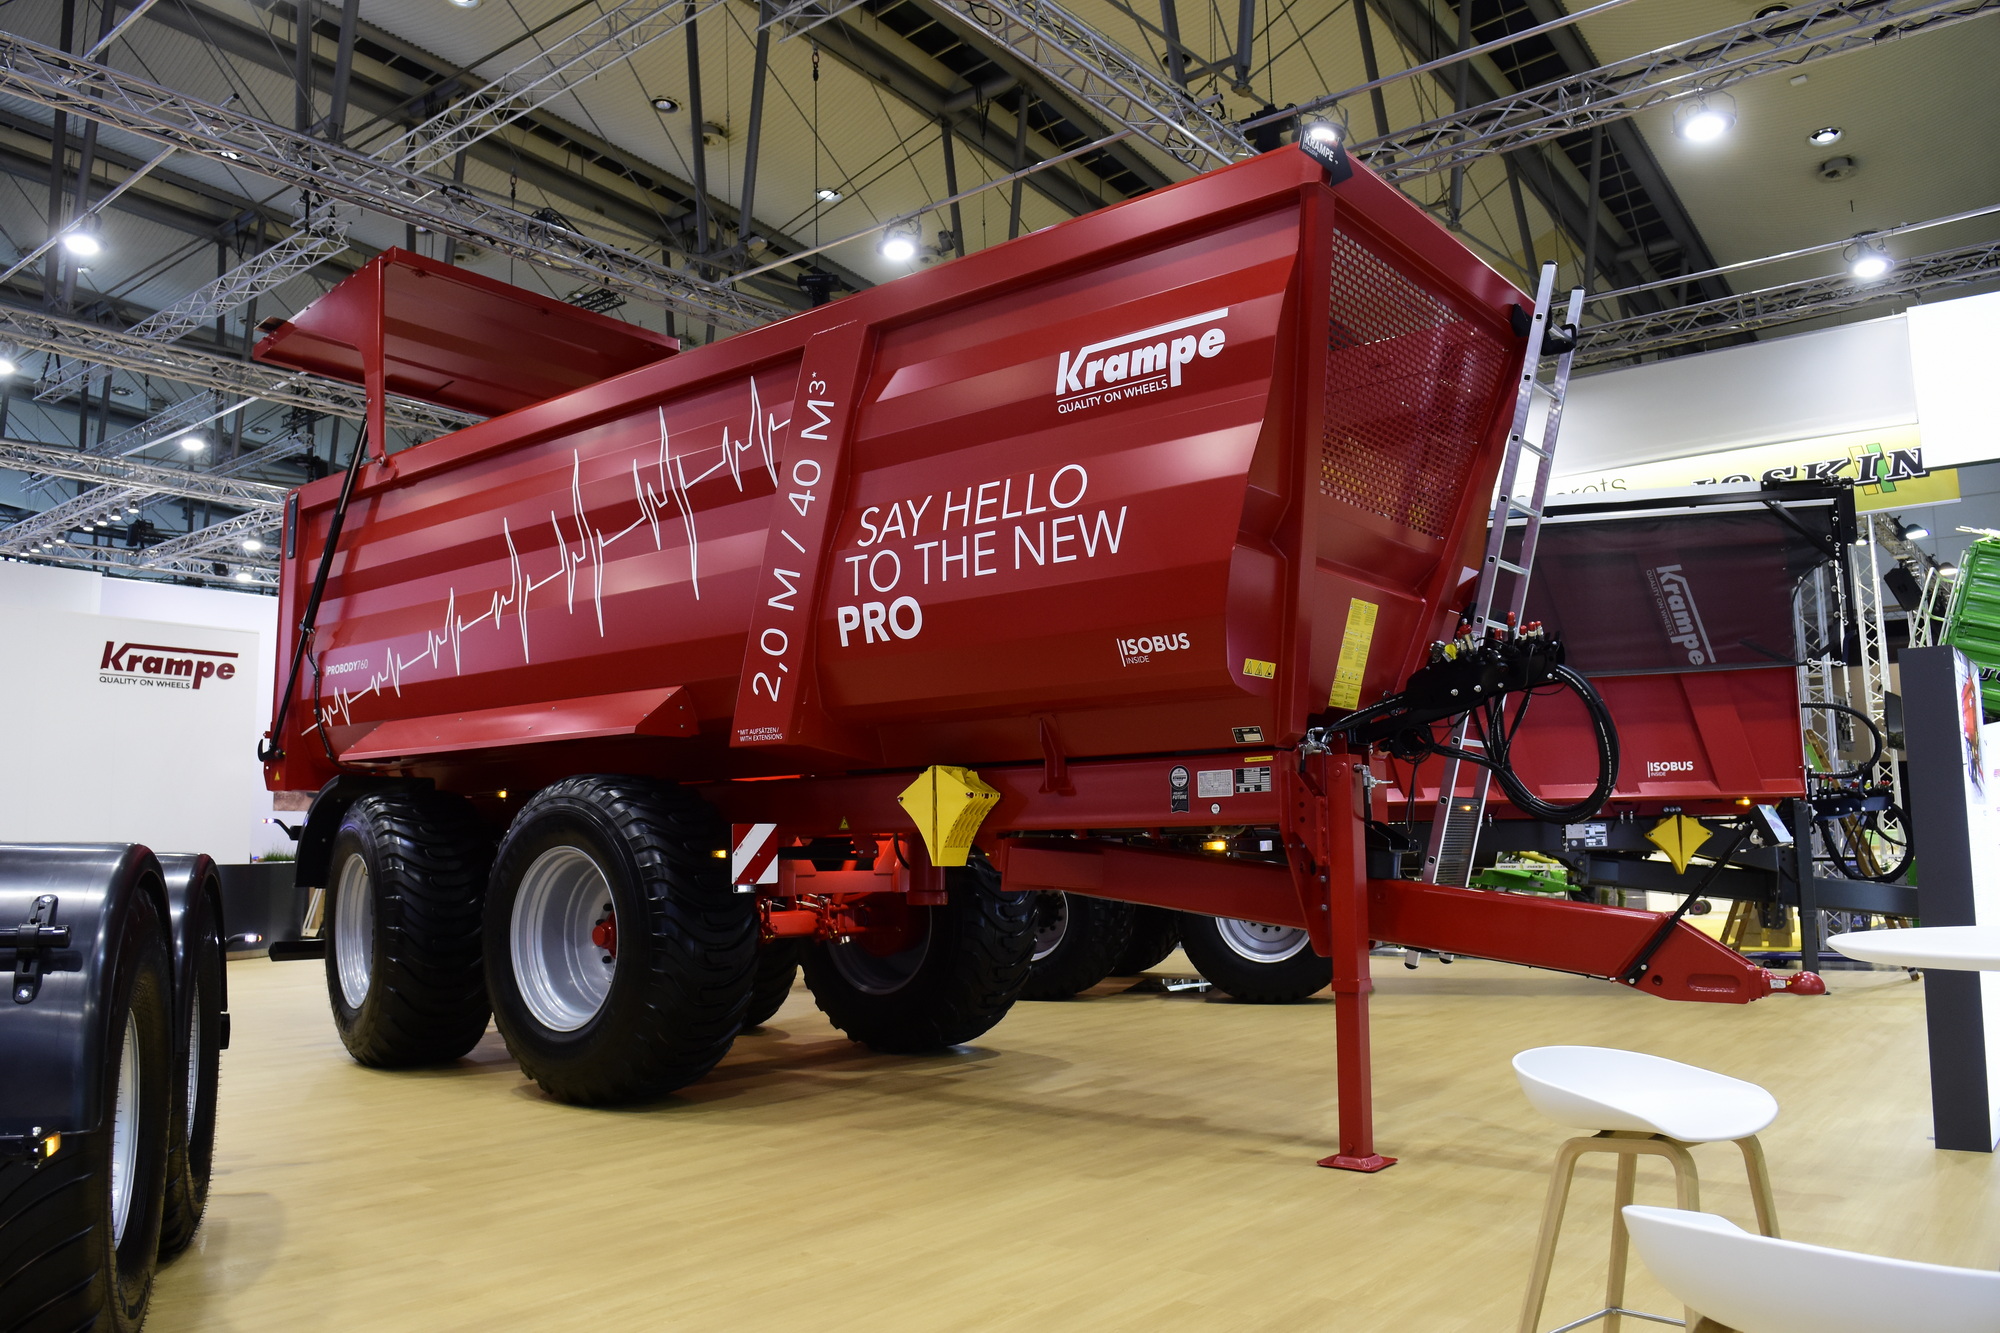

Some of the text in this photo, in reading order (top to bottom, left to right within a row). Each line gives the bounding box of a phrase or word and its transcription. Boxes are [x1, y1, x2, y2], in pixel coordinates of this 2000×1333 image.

[1056, 307, 1229, 395] Krampe
[1057, 379, 1168, 414] QUALITY ON WHEELS
[788, 459, 821, 516] 40
[857, 464, 1088, 547] SAY HELLO
[781, 529, 806, 553] /
[845, 505, 1127, 596] TO THE NEW
[768, 568, 800, 611] M
[1646, 569, 1675, 636] QUALITY ON WHEELS
[837, 595, 923, 647] PRO
[1656, 564, 1717, 666] Krampe
[100, 641, 239, 690] Krampe
[752, 628, 788, 701] 2,0
[1121, 632, 1191, 656] ISOBUS
[1125, 655, 1150, 665] INSIDE
[99, 676, 138, 686] QUALITY
[155, 681, 190, 689] WHEELS
[752, 733, 783, 742] EXTENSIONS
[1650, 761, 1694, 772] ISOBUS
